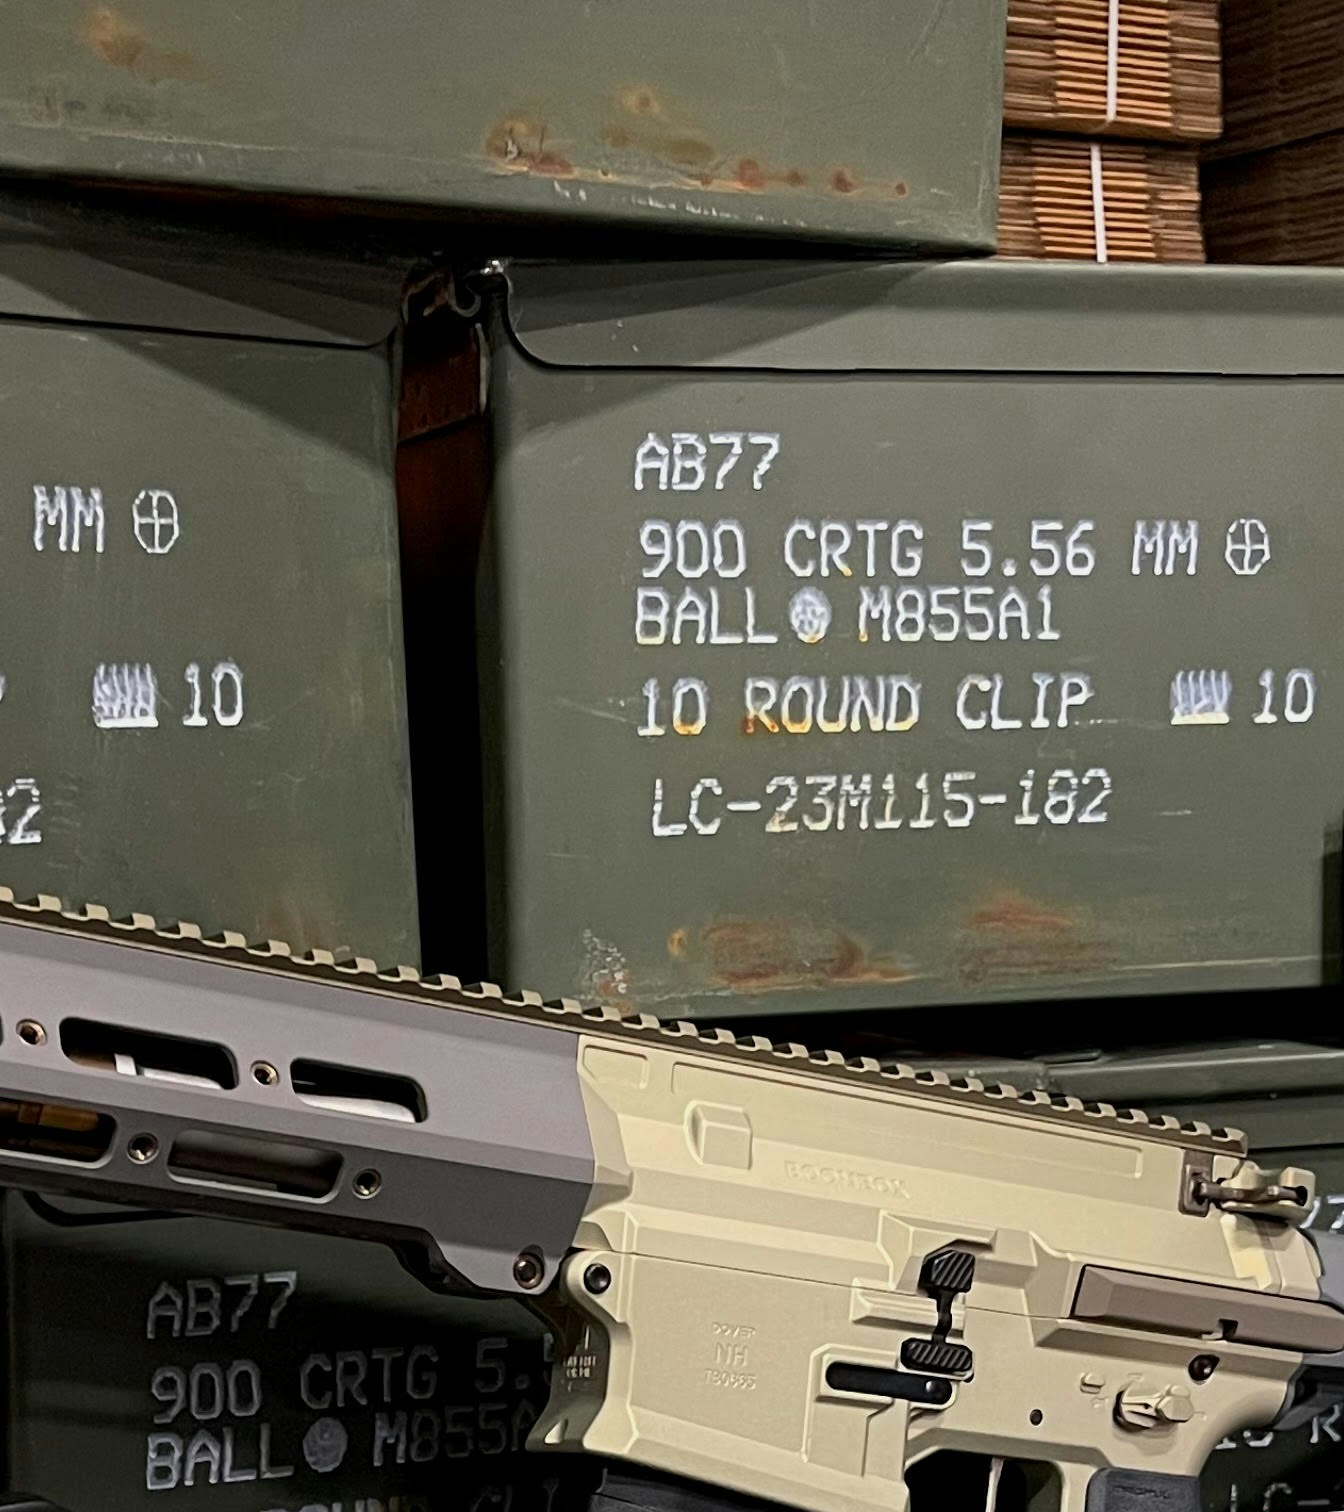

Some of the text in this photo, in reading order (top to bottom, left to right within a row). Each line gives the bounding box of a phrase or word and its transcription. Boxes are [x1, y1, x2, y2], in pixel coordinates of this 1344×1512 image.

[633, 432, 780, 490] AB77
[33, 486, 105, 553] MM
[639, 518, 1198, 577] 900 CRTG 5.56 MM
[635, 585, 1060, 645] BALL M855A1
[182, 662, 244, 728] 10
[637, 667, 1315, 735] 10 ROUND CLIP 10
[652, 768, 1112, 836] LC-23M115-182
[146, 1270, 297, 1339] AB77
[152, 1360, 262, 1424] 900
[300, 1344, 439, 1410] CRTG
[714, 1341, 749, 1368] NH
[146, 1403, 538, 1491] BALL M855A
